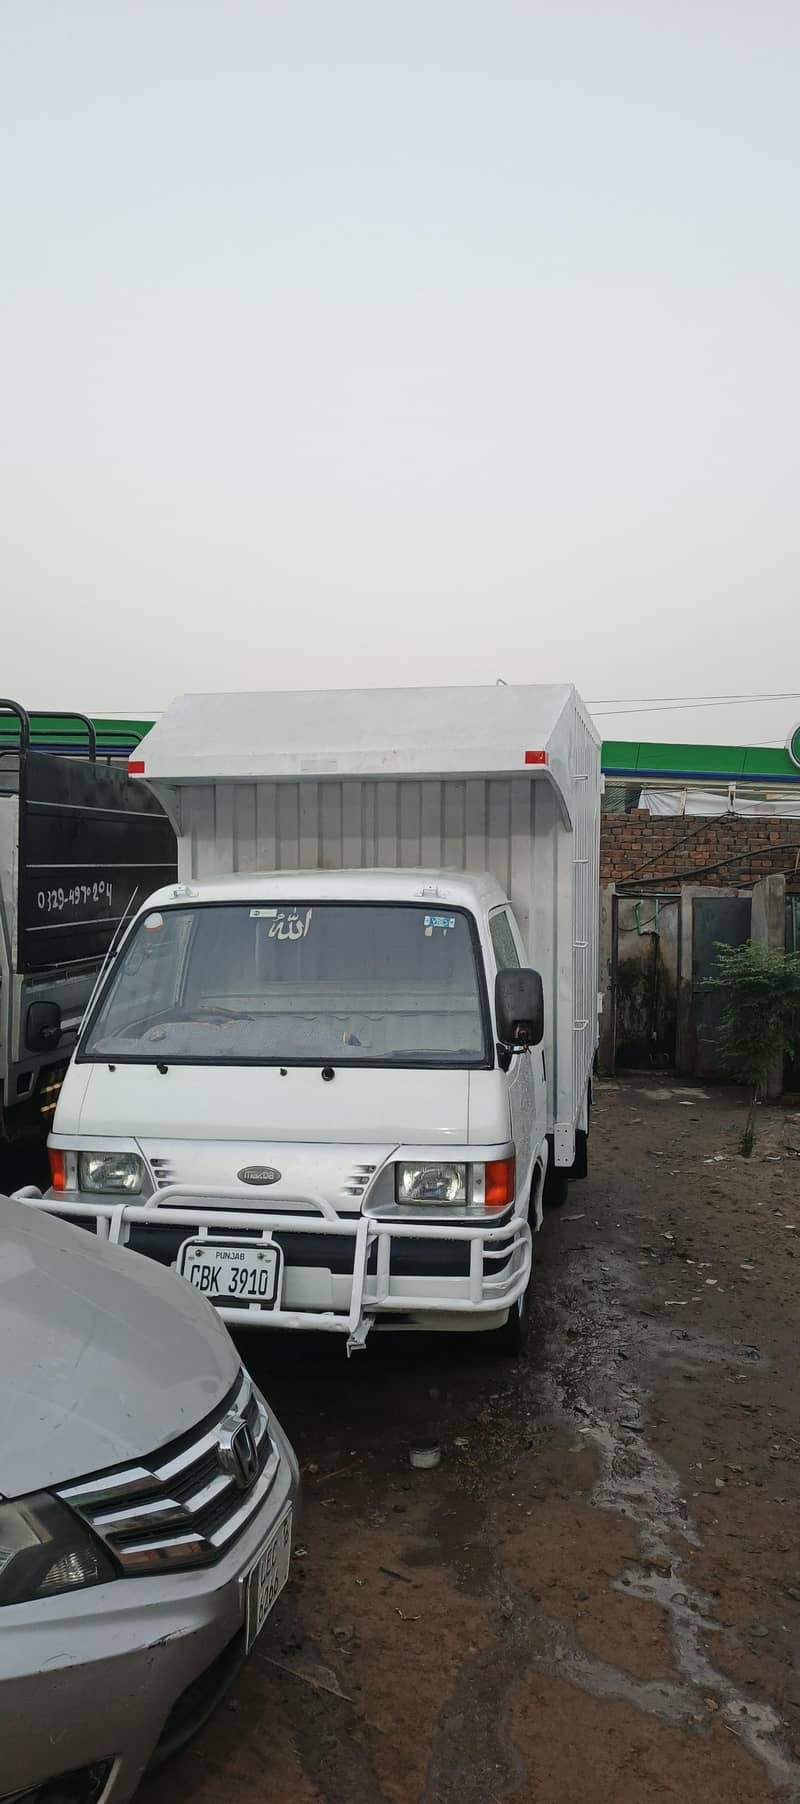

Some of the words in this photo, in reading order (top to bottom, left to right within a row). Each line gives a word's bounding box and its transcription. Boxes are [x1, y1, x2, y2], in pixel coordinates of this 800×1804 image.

[215, 1251, 245, 1261] PUNJAB
[190, 1264, 222, 1292] CBK
[229, 1267, 268, 1295] 3910
